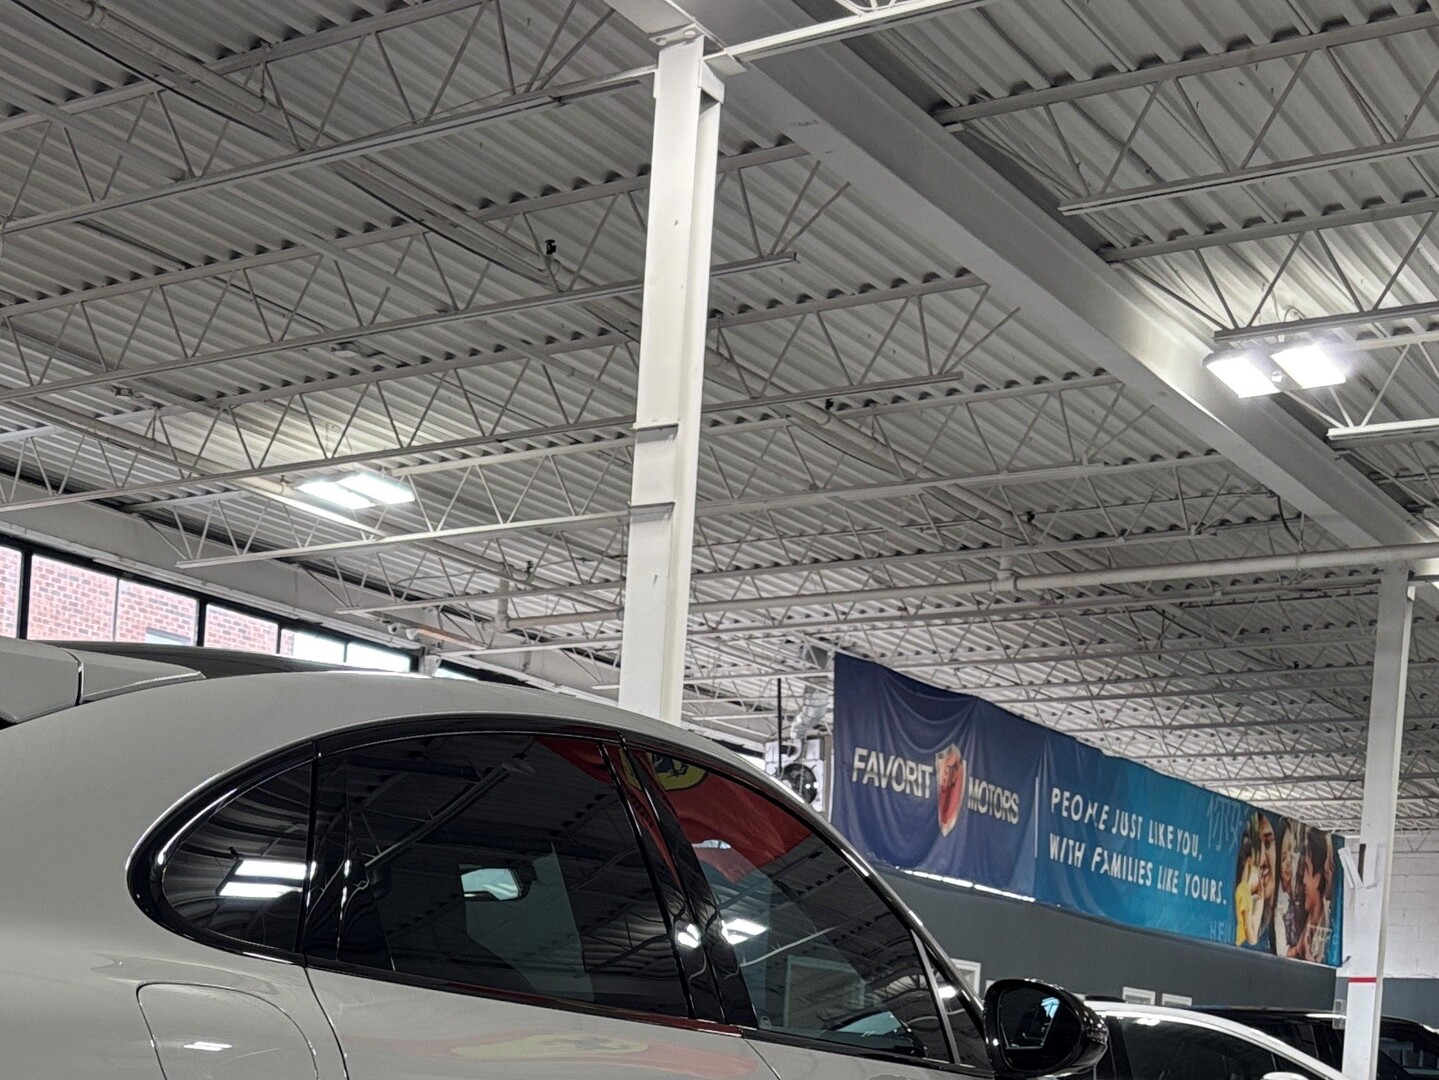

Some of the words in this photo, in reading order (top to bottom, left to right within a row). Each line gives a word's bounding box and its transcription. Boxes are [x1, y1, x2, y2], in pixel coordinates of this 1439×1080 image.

[852, 747, 934, 799] FAVORIT
[967, 776, 1020, 825] MOTORS
[1050, 832, 1086, 868] WITH
[1091, 846, 1154, 887] FAMILIES
[1157, 865, 1178, 894] LIKE
[1185, 873, 1227, 905] YOURS.
[1111, 808, 1143, 841] JUST
[1148, 819, 1174, 850] LIKE
[1177, 828, 1203, 861] YOU,
